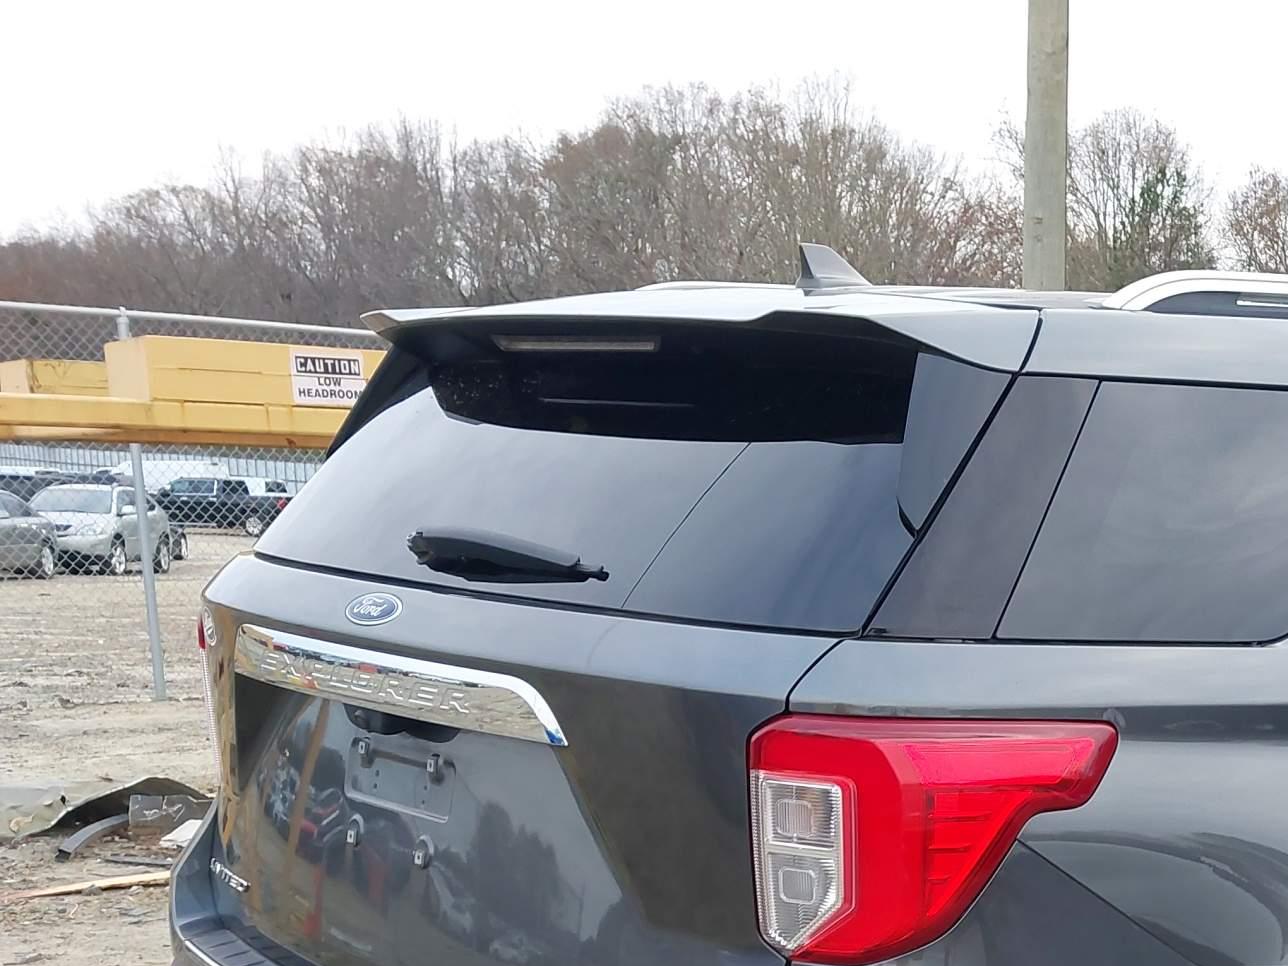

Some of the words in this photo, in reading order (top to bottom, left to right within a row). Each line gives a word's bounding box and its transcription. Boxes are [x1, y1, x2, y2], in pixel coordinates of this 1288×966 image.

[296, 357, 360, 374] CAUTION
[317, 376, 342, 387] LOW
[353, 596, 388, 617] Ford
[260, 652, 471, 714] EXPLORER
